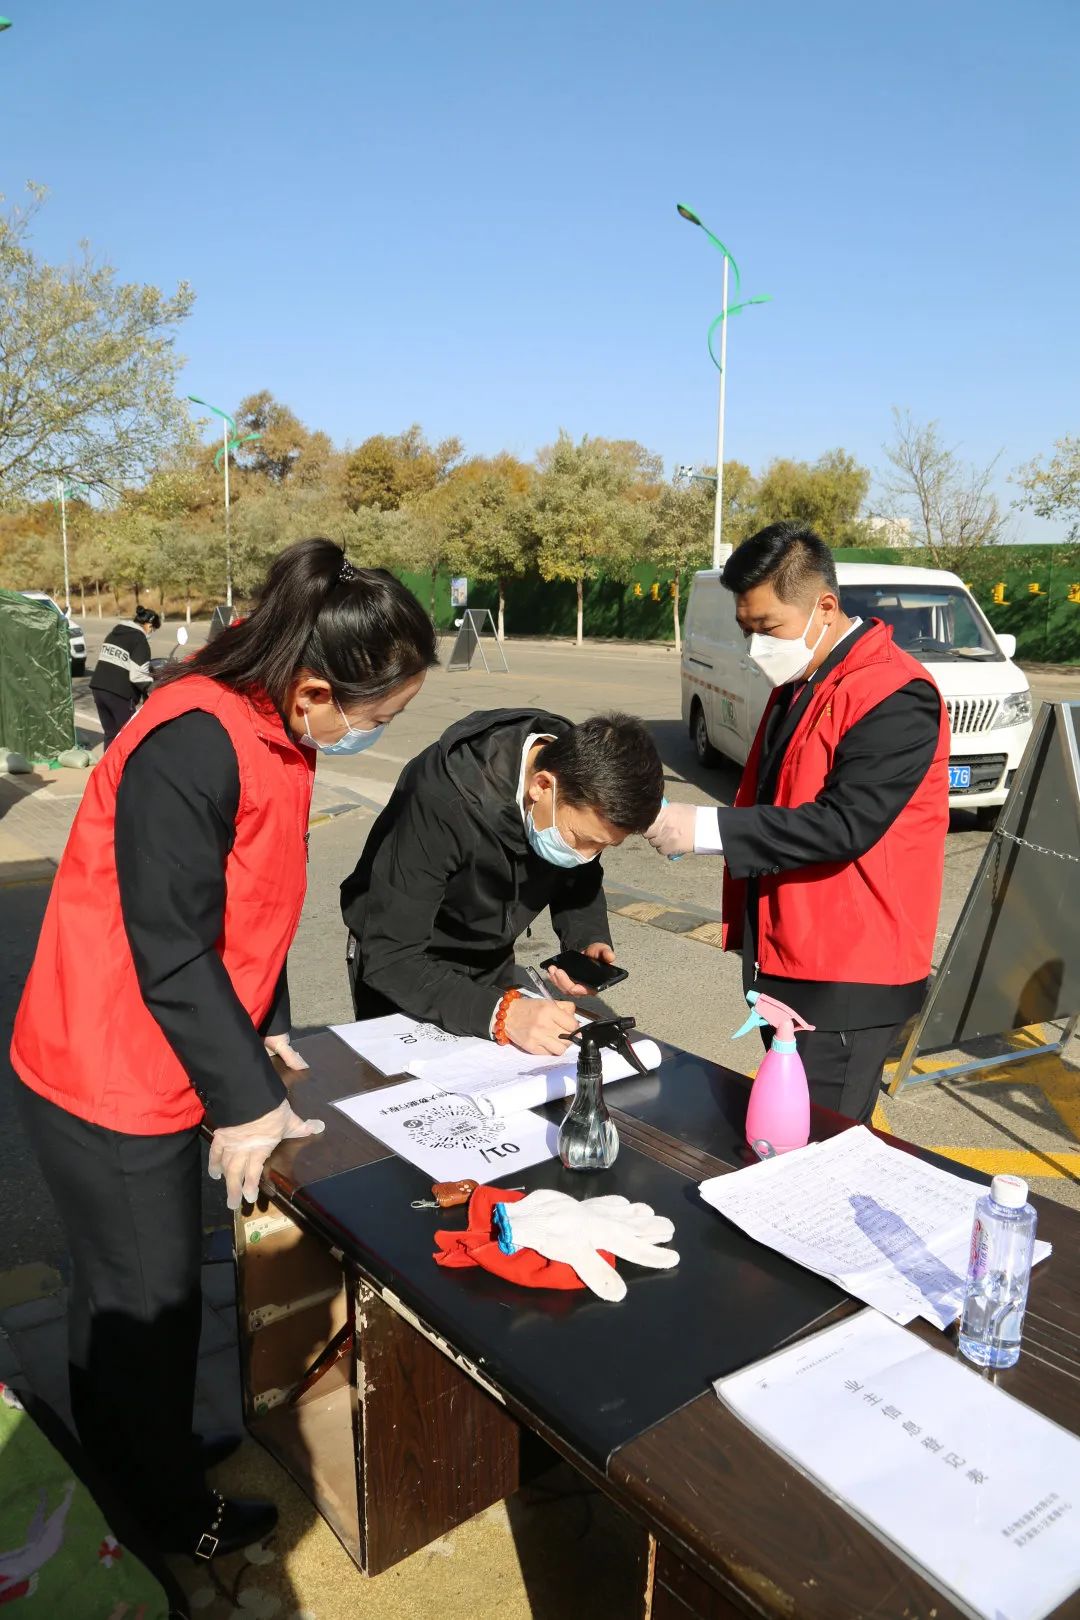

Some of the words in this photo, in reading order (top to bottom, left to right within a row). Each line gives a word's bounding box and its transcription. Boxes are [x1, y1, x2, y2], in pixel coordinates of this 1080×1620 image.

[479, 1142, 521, 1164] 01/
[844, 1379, 989, 1484] 业主信息登记表
